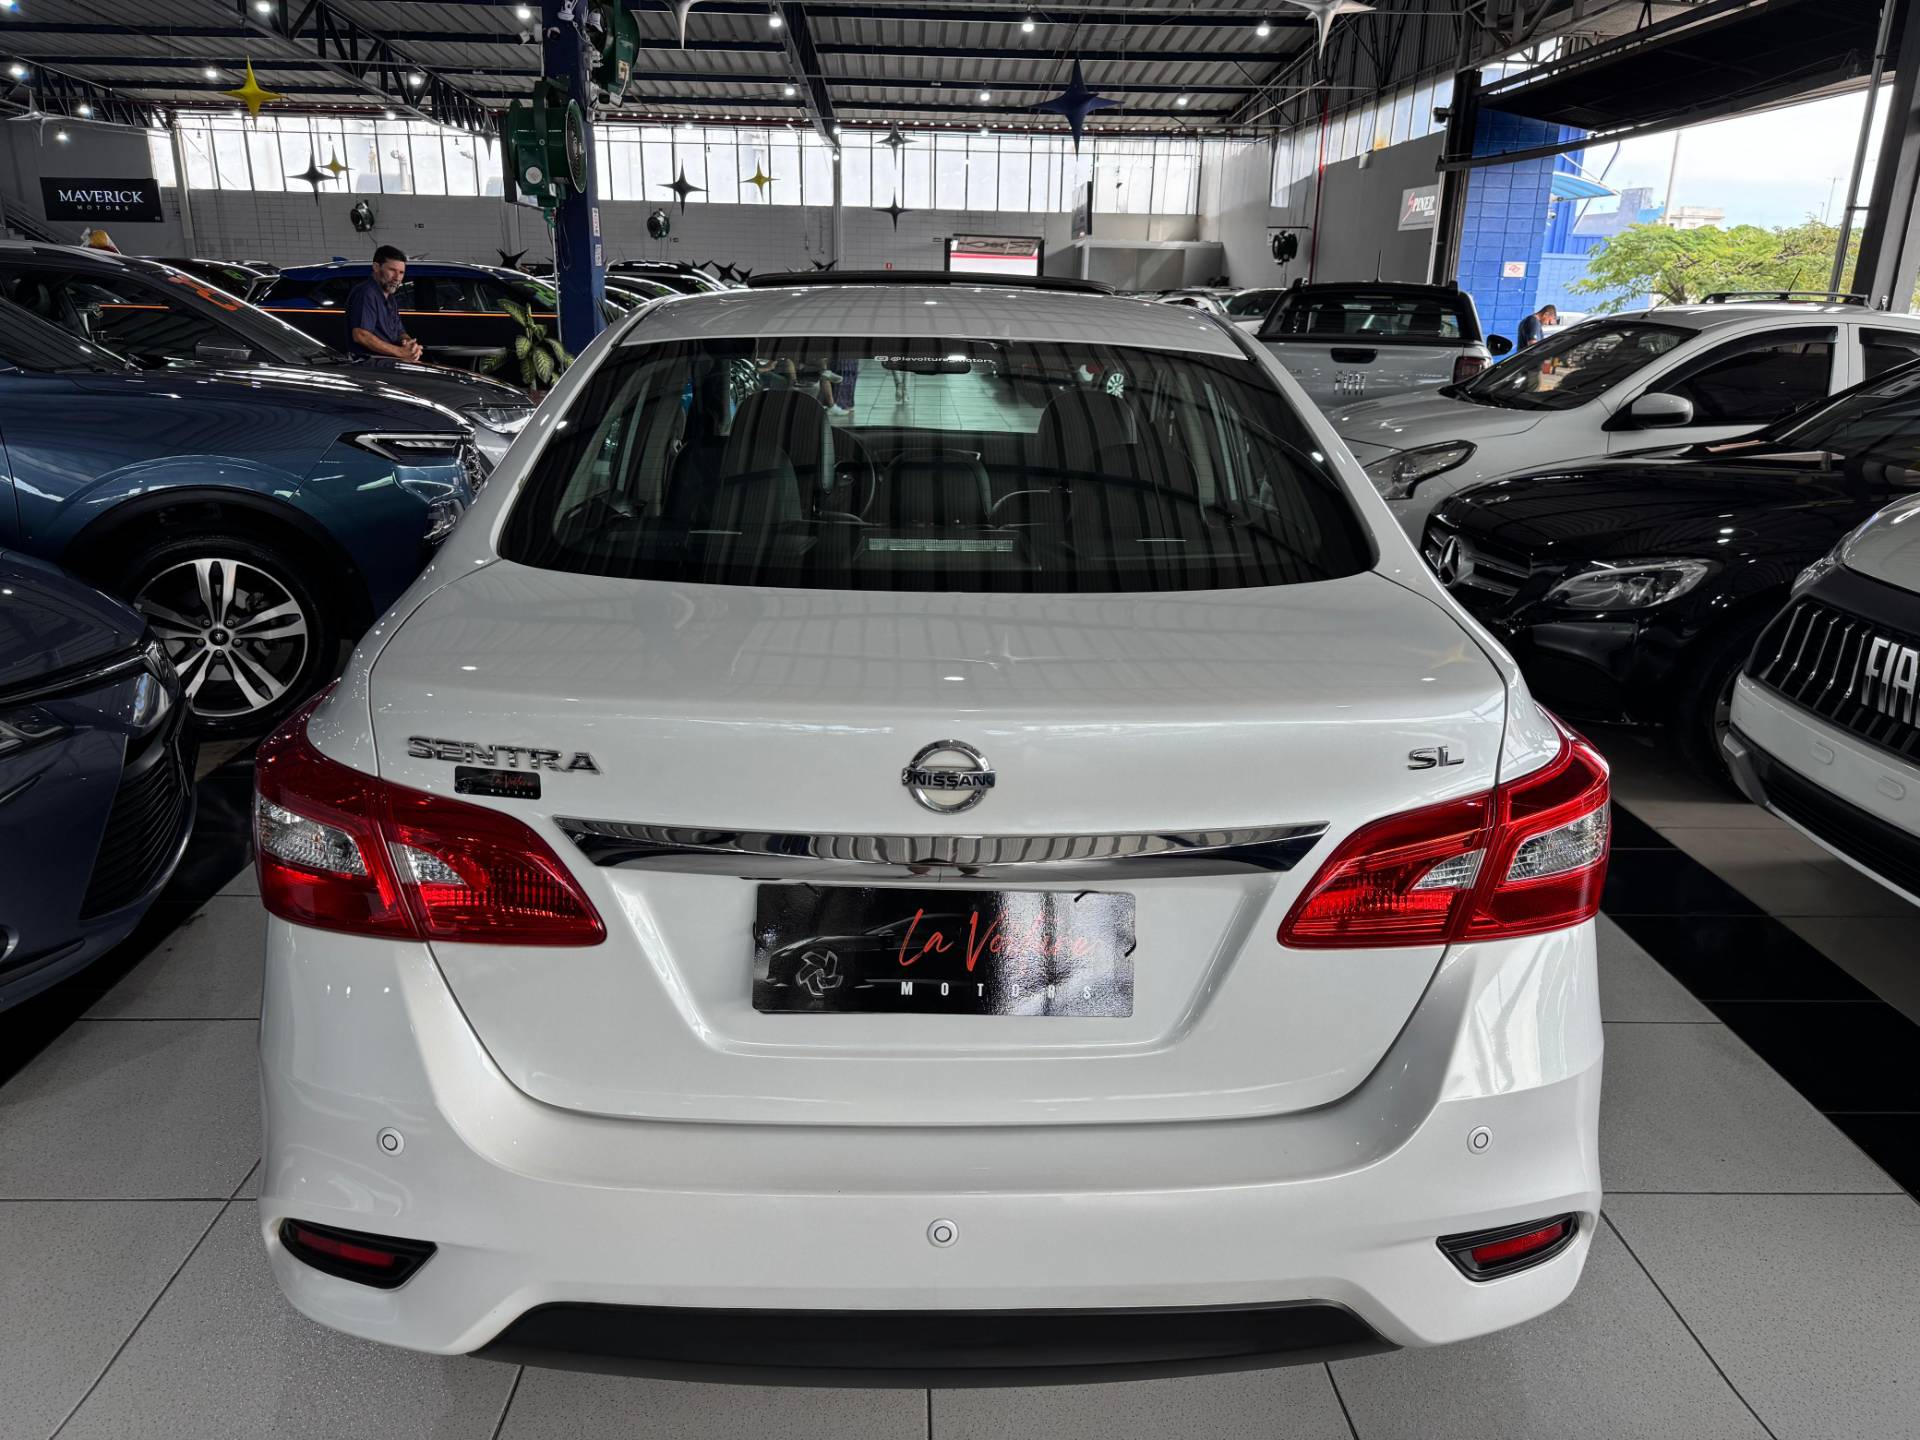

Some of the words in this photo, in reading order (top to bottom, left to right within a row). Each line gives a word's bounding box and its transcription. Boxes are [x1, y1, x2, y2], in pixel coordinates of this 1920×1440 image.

[58, 189, 144, 203] MAVERICK
[1861, 636, 1920, 729] FIA
[407, 735, 603, 775] SENTRA
[1408, 746, 1465, 770] SL
[912, 772, 986, 788] NISSAN
[899, 908, 956, 967] La
[901, 982, 1092, 1001] MOTORS
